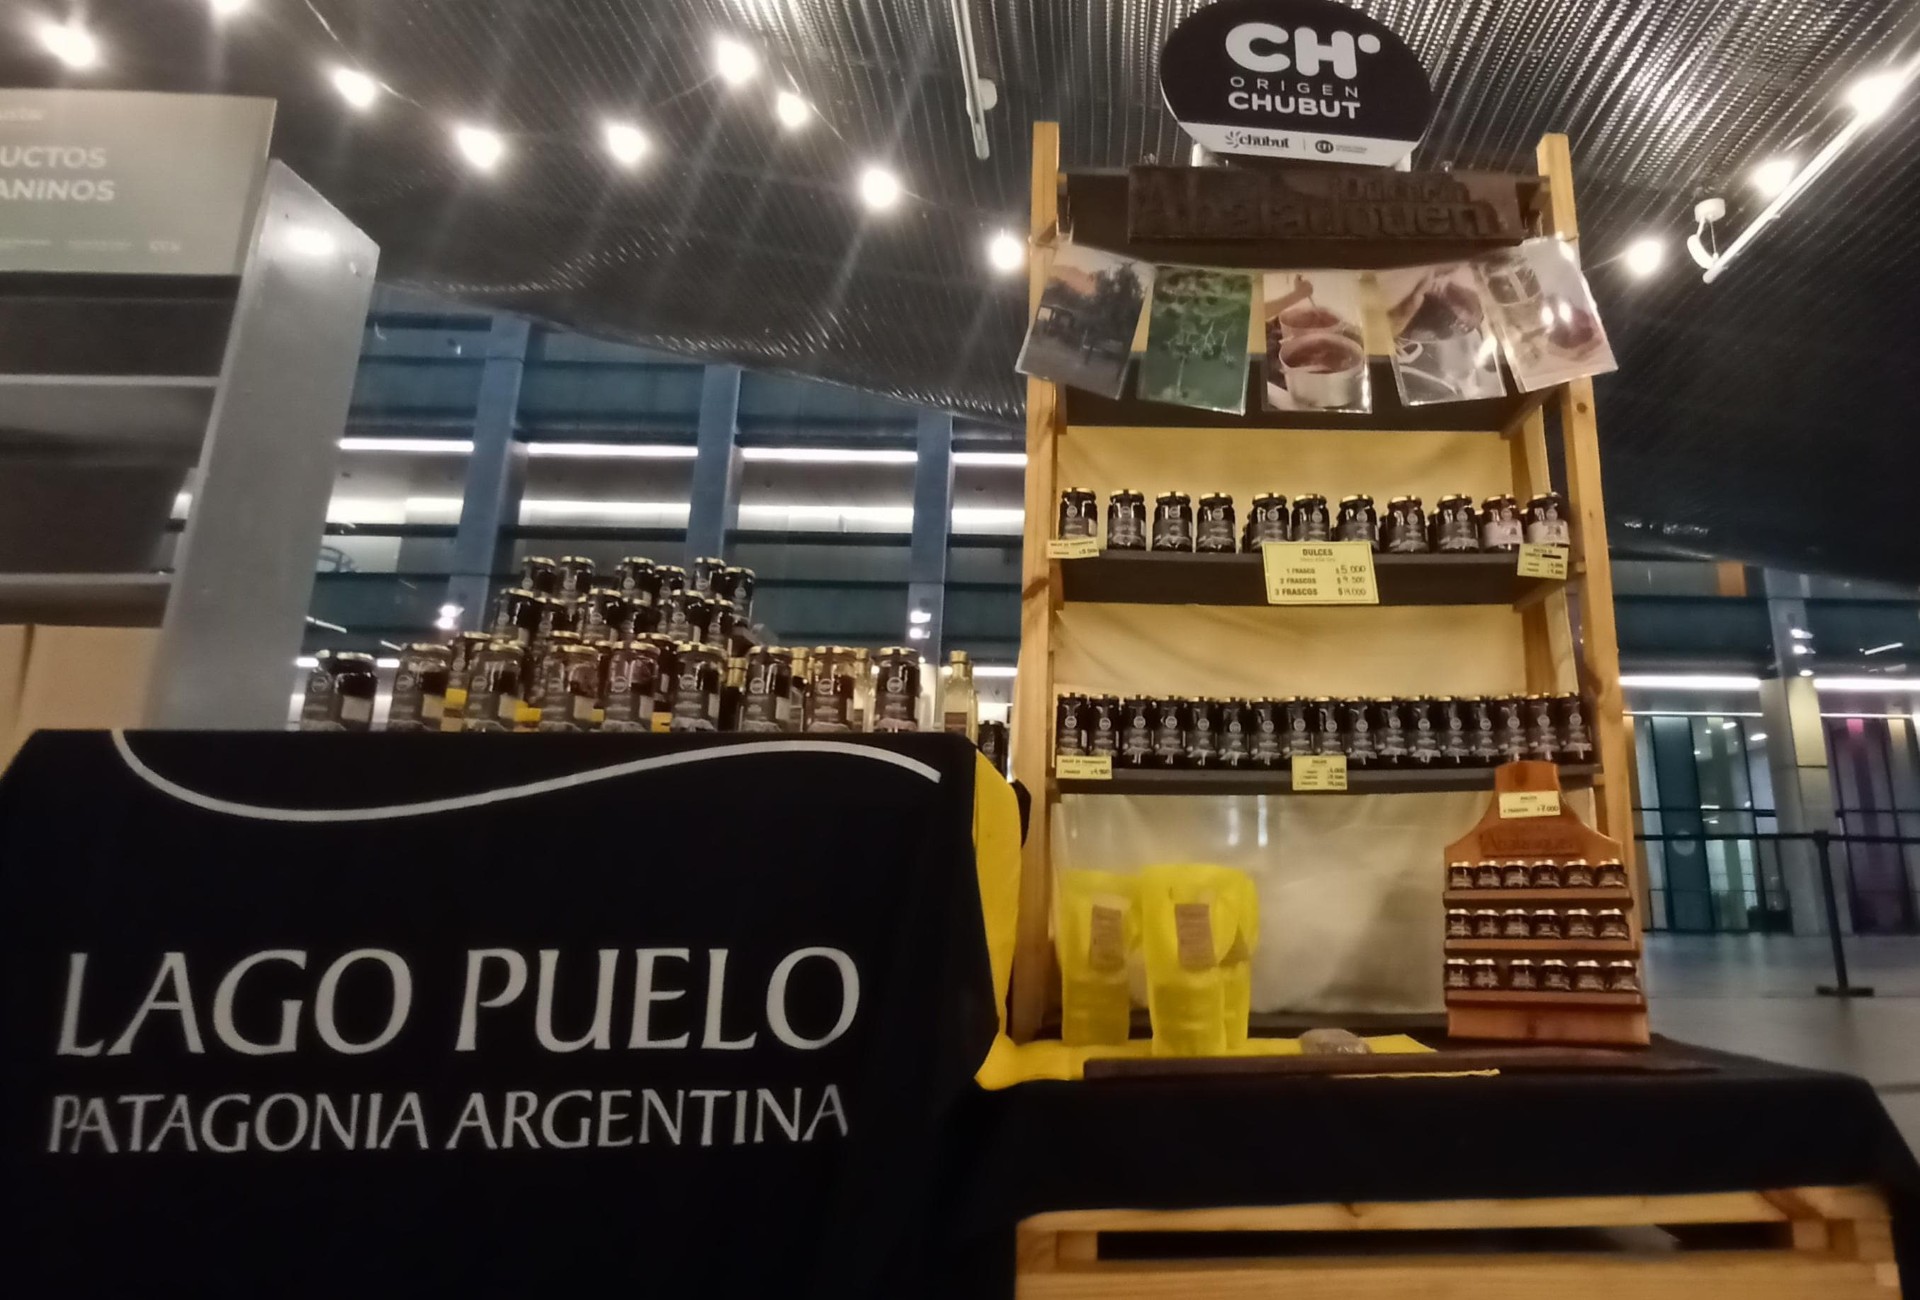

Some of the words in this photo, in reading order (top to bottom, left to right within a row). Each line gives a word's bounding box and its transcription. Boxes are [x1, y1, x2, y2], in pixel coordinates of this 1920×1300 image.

[1229, 75, 1359, 98] ORIGEN
[1227, 91, 1361, 119] CHUBUT
[1239, 133, 1290, 149] chubut
[1302, 548, 1333, 557] DULCES
[1291, 567, 1316, 575] FRASCO
[1286, 577, 1317, 585] FRASCOS
[1281, 587, 1318, 596] FRASCOS
[57, 948, 412, 1056] LAGO
[455, 947, 860, 1052] PUELO
[49, 1092, 429, 1153] PATAGONIA
[446, 1085, 848, 1149] ARGENTINA
